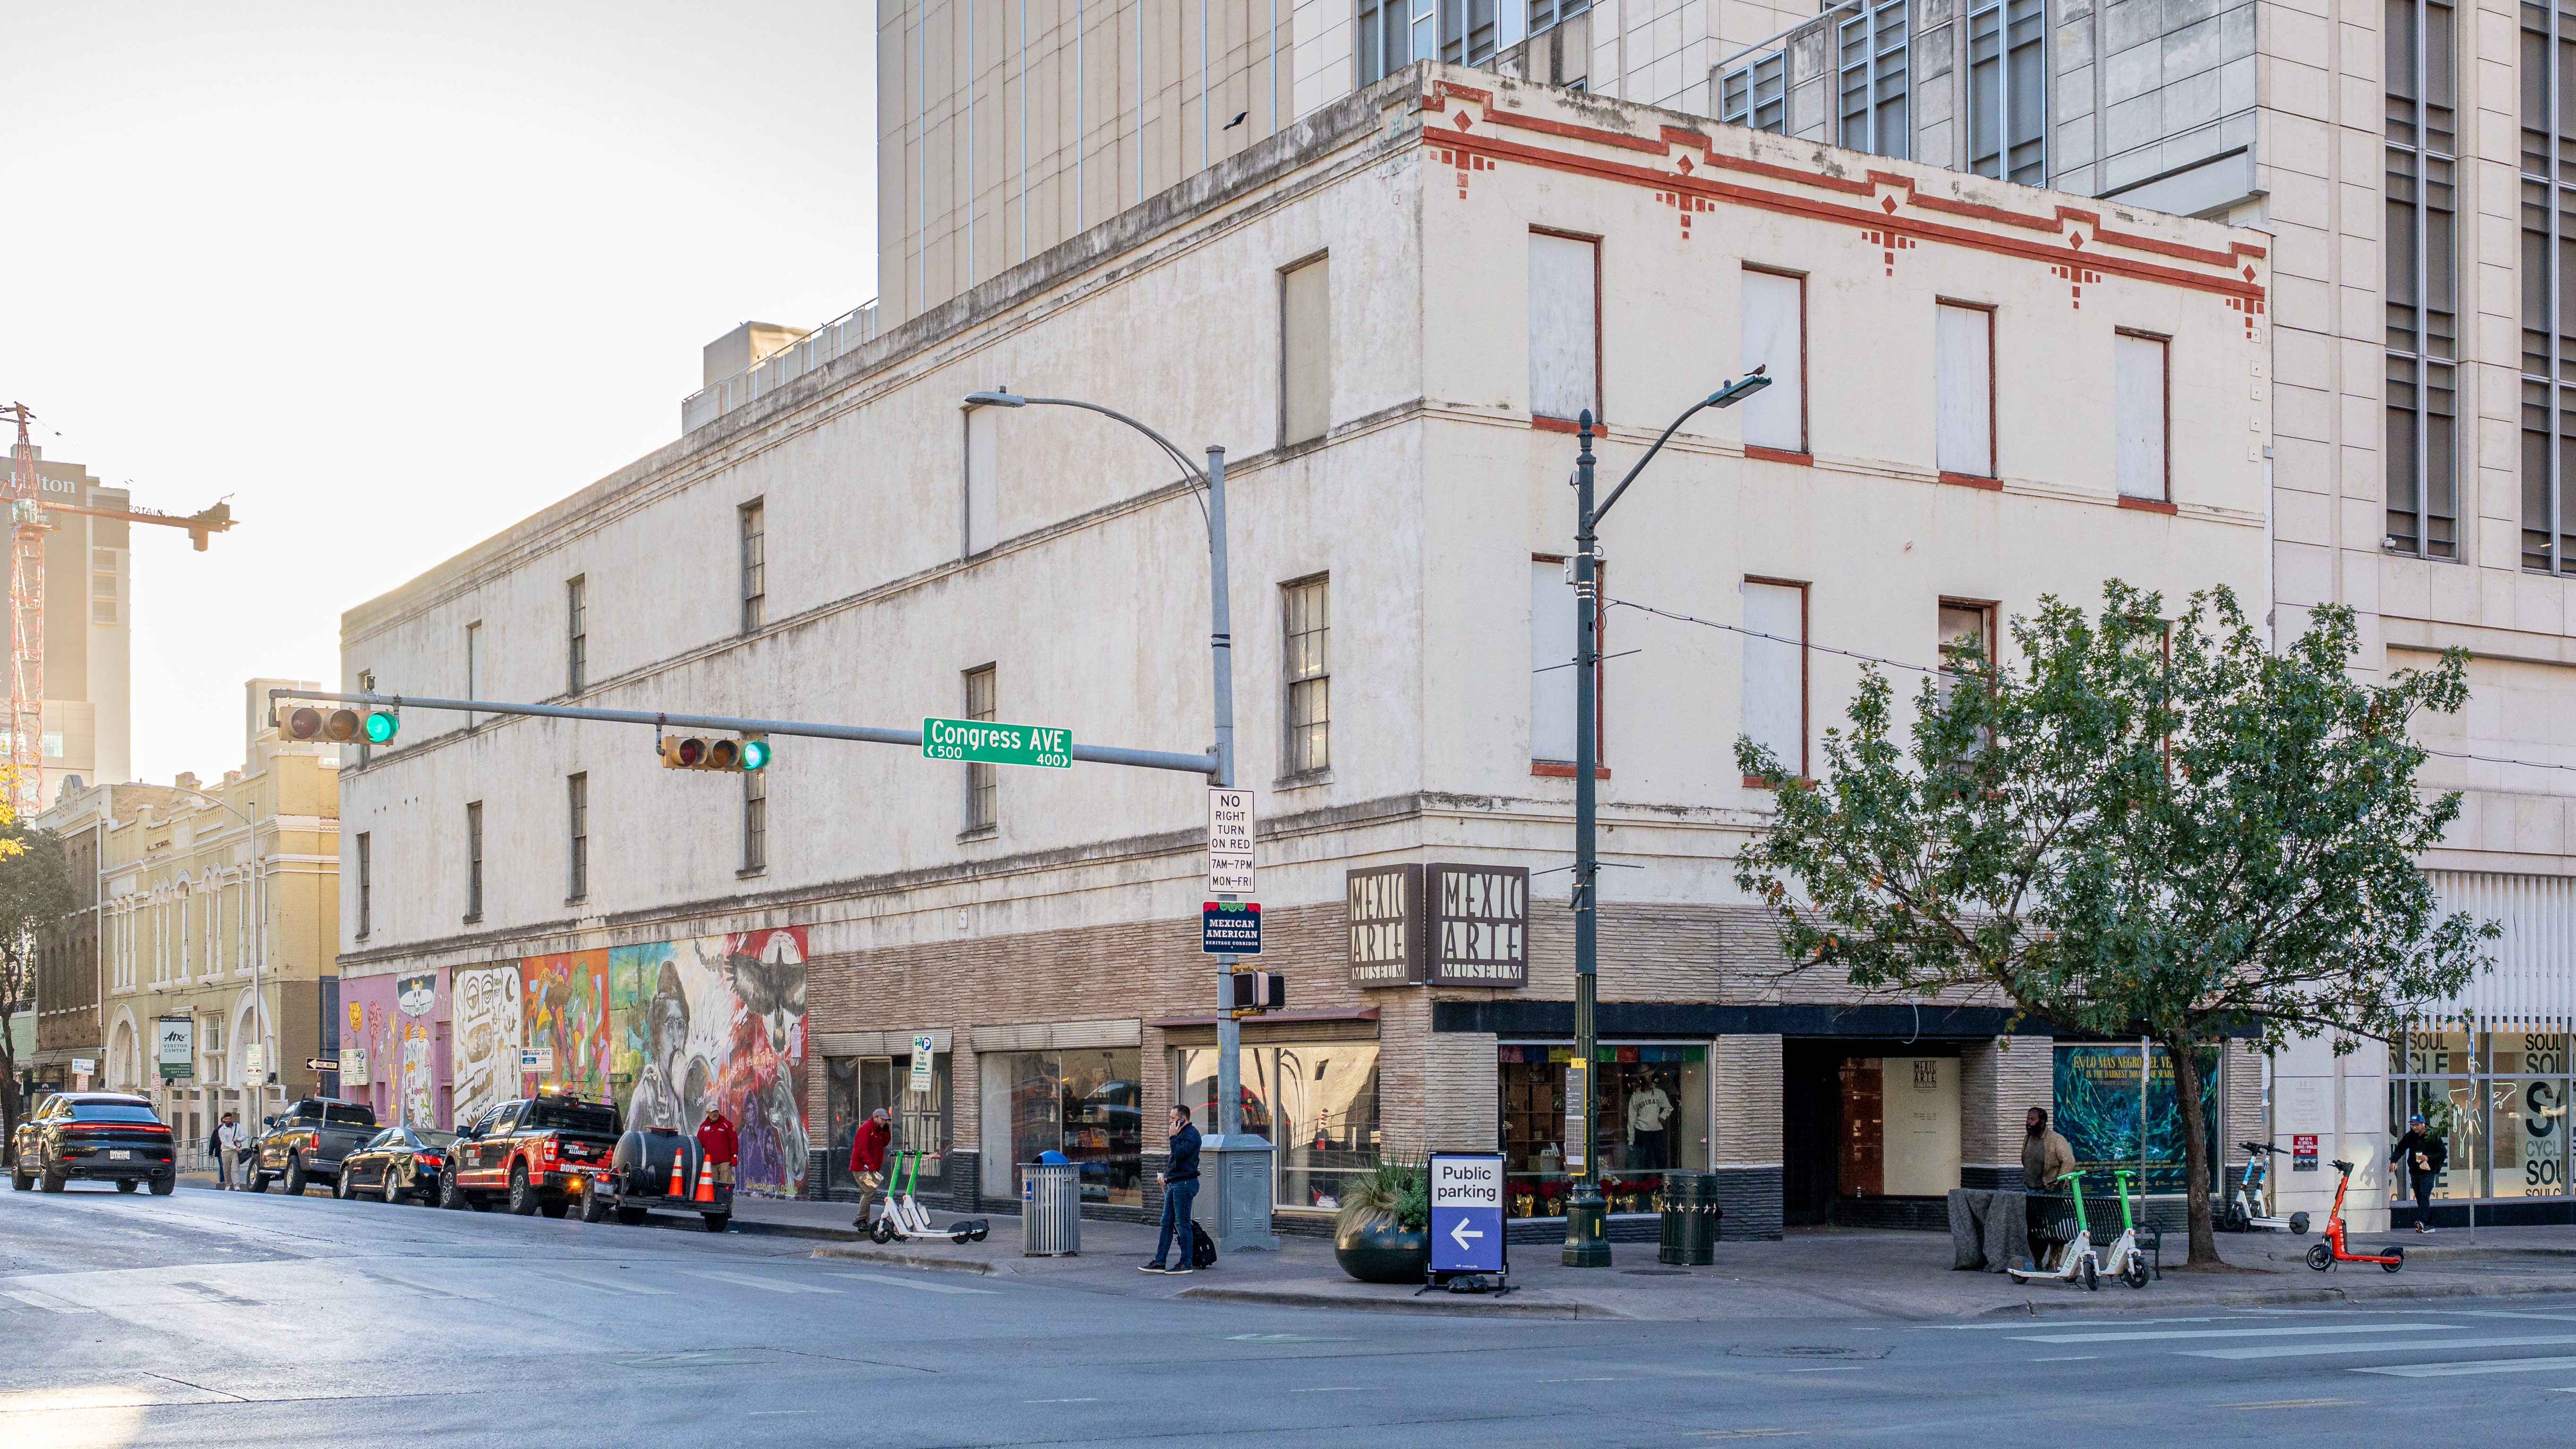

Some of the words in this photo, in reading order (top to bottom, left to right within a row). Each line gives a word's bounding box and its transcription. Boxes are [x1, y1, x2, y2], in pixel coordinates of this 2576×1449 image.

[10, 472, 76, 493] Hlton
[932, 720, 1021, 751] Congress
[1029, 729, 1064, 752] AVE
[937, 746, 963, 759] 500
[1036, 754, 1061, 766] 400
[1221, 795, 1240, 807] NO
[1216, 811, 1245, 821] RIGHT
[1218, 825, 1244, 835] TURN
[1212, 839, 1225, 848] ON
[1231, 839, 1250, 849] RED
[1209, 919, 1255, 928] MEXICAN
[1206, 929, 1258, 939] AMERICAN
[1442, 921, 1522, 960] ARTE
[1352, 922, 1404, 962] ARTE
[1352, 964, 1405, 980] MUSEUM
[1442, 964, 1521, 979] MUSEUM
[2409, 1032, 2448, 1051] SOUL
[2074, 1056, 2084, 1068] EN
[2086, 1056, 2096, 1068] LO
[2118, 1056, 2142, 1068] NEGRO
[1914, 1072, 1935, 1082] ARTE
[2086, 1070, 2092, 1078] IN
[2093, 1070, 2103, 1078] THE
[2105, 1070, 2127, 1078] DARKEST
[2150, 1070, 2157, 1078] OF
[1443, 1166, 1491, 1180] Public
[1438, 1184, 1496, 1202] parking
[2065, 1249, 2077, 1268] Lime
[2110, 1247, 2122, 1266] Lime
